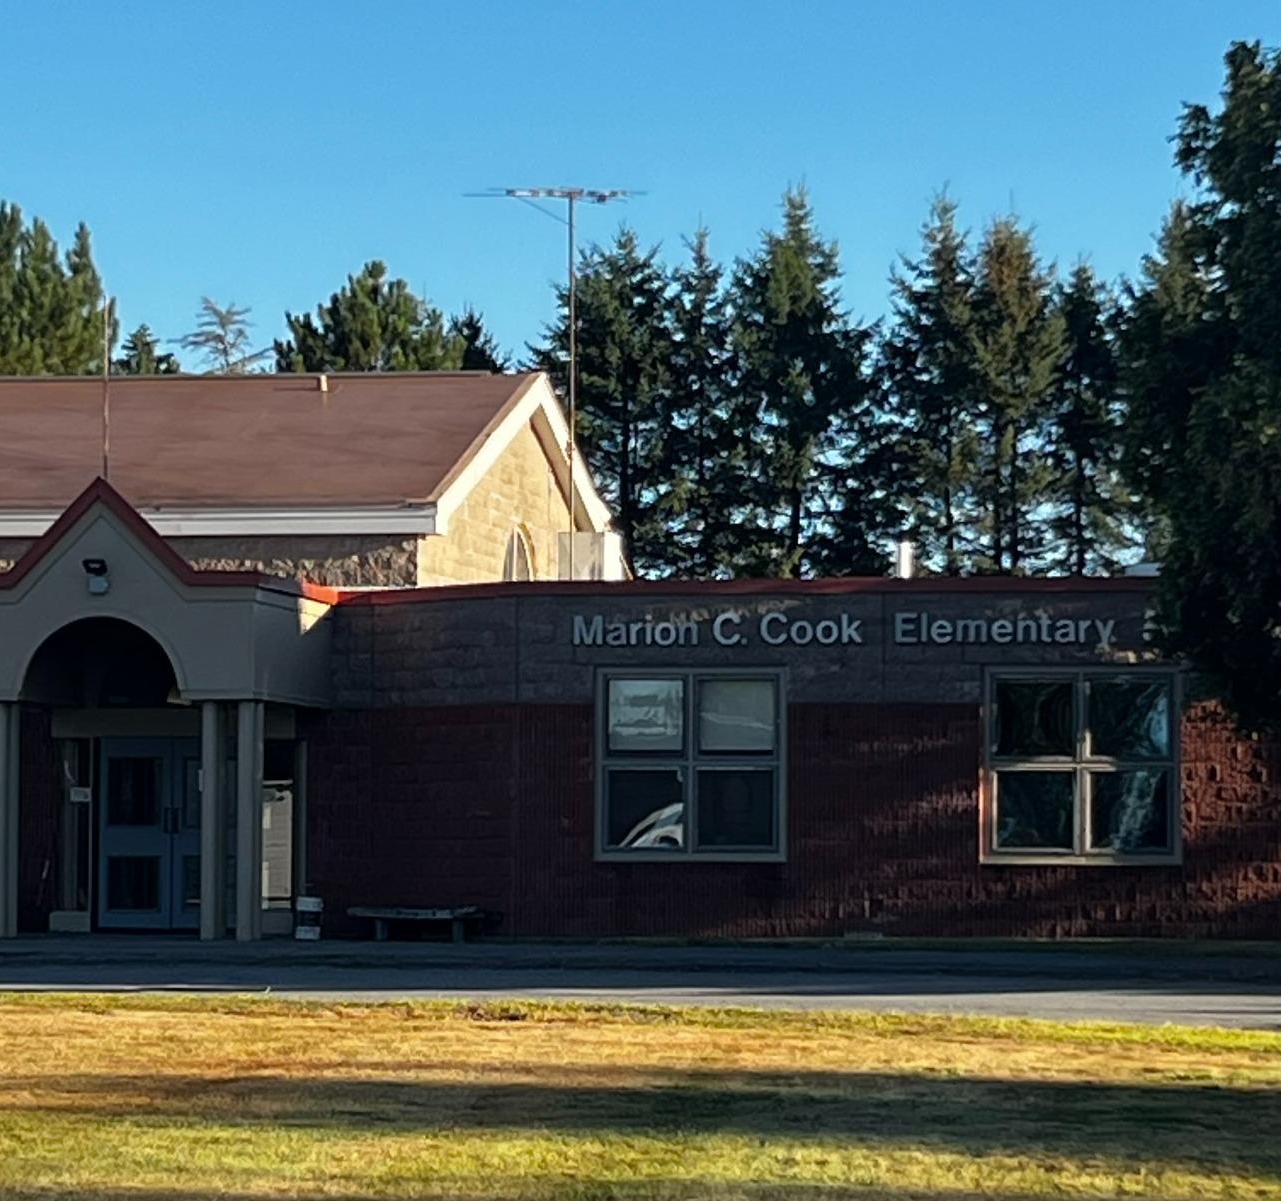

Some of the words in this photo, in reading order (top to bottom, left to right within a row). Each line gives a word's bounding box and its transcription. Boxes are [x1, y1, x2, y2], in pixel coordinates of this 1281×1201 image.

[572, 614, 699, 646] Marion
[712, 612, 748, 646] C.
[760, 612, 863, 645] Cook
[894, 612, 1116, 650] Elementary
